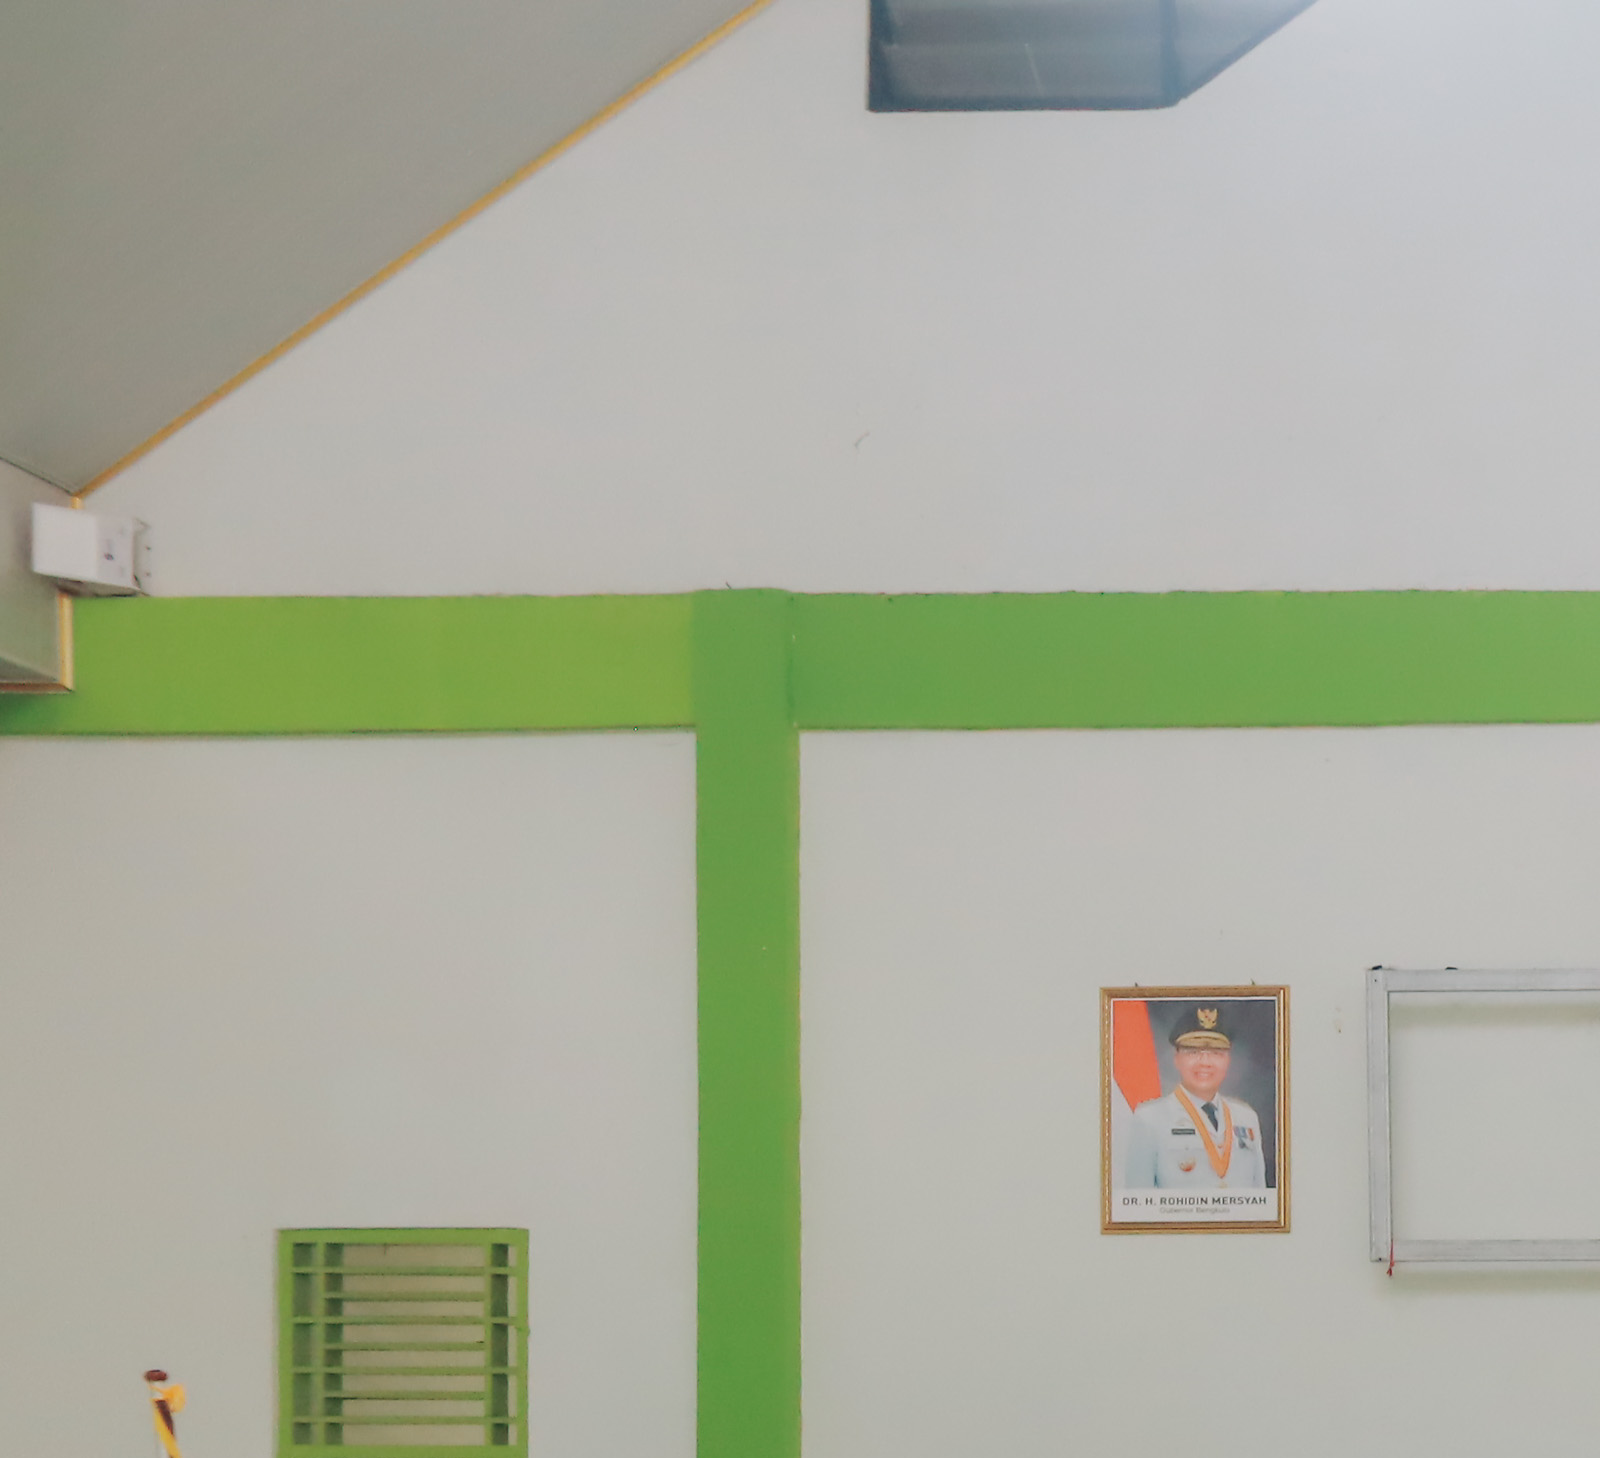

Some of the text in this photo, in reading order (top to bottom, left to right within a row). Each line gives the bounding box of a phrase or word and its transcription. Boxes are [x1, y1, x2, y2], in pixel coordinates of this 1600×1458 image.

[1122, 1196, 1267, 1206] DR. H. ROHIDIN MERSYAH
